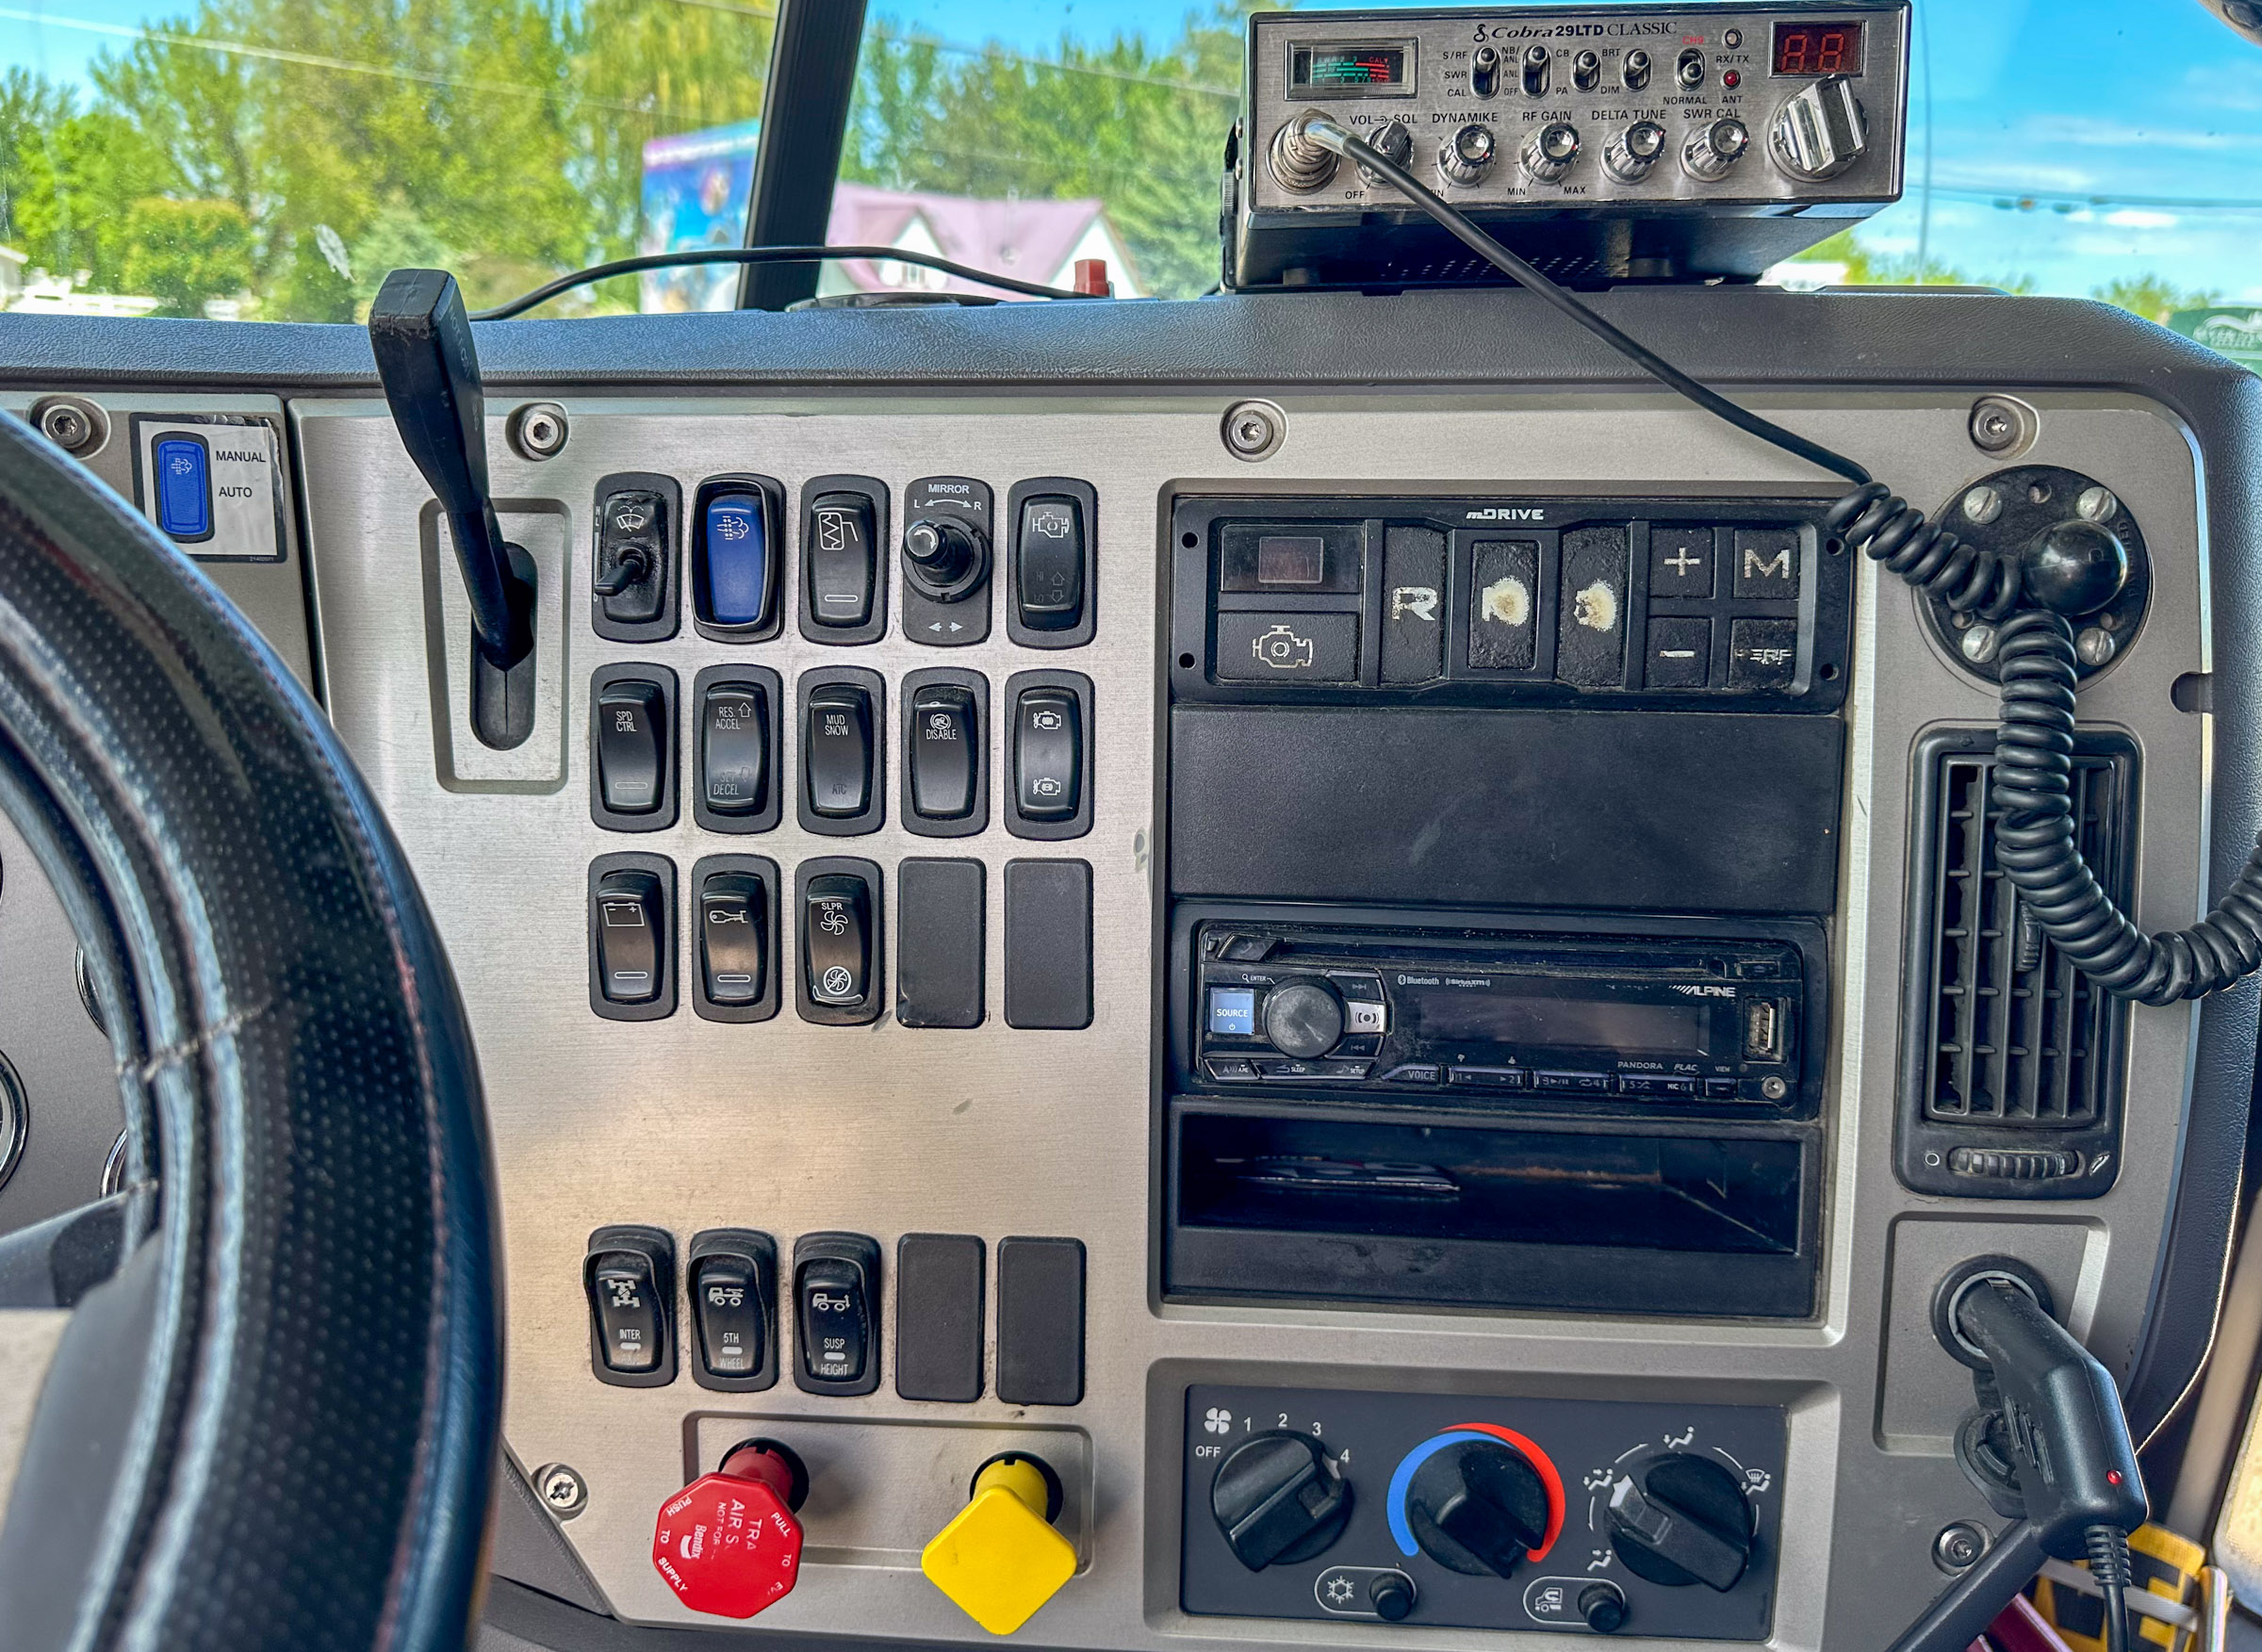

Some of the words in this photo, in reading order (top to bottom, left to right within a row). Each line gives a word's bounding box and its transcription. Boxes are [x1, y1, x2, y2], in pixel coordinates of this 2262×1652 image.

[1492, 25, 1554, 39] Cobra
[1555, 25, 1604, 37] 29LTD
[1607, 22, 1678, 36] CLASSIC
[1682, 36, 1704, 44] CH9
[1443, 51, 1467, 59] S/RF
[1501, 45, 1520, 55] NB/
[1556, 49, 1570, 57] CB
[1502, 56, 1518, 64] ANL
[1715, 55, 1750, 63] RX/TX
[1447, 89, 1467, 97] CAL
[1503, 88, 1518, 96] OFF
[1556, 87, 1568, 95] PA
[1601, 86, 1620, 94] DIM
[1663, 96, 1708, 105] NORMAL
[1394, 114, 1418, 124] SQL
[1432, 112, 1499, 123] DYNAMIKE
[1522, 111, 1537, 122] RF
[1541, 110, 1572, 121] GAIN
[1592, 110, 1629, 121] DELTA
[1633, 109, 1667, 120] TUNE
[1683, 109, 1713, 119] SWR
[1716, 108, 1741, 119] CAL
[1350, 115, 1374, 125] VOL
[1345, 190, 1365, 199] OFF
[216, 450, 267, 463] MANUAL
[219, 486, 253, 498] AUTO
[928, 484, 970, 495] MIRROR
[914, 499, 920, 509] L
[974, 501, 982, 511] R
[1744, 548, 1790, 579] M
[1391, 586, 1438, 622] R
[616, 711, 633, 722] SPD
[827, 714, 845, 726] MUD
[616, 722, 637, 732] CTRL
[715, 718, 741, 730] ACCEL
[825, 726, 848, 736] SNOW
[926, 729, 958, 740] DISABLE
[713, 784, 739, 795] DECEL
[832, 784, 847, 795] ATC
[821, 902, 844, 910] SLPR
[1406, 975, 1440, 986] Bluetooth
[1682, 986, 1736, 997] ALPINE
[1216, 1008, 1249, 1018] SOURCE
[1617, 1061, 1664, 1070] PANDORA
[1408, 1071, 1435, 1081] VOICE
[619, 1329, 641, 1340] INTER
[724, 1332, 740, 1344] 5TH
[824, 1337, 845, 1349] SUSP
[719, 1357, 745, 1370] WHEEL
[821, 1363, 849, 1376] HEIGHT
[1243, 1416, 1253, 1431] 1
[1277, 1413, 1288, 1428] 2
[1312, 1421, 1322, 1436] 3
[1339, 1448, 1351, 1464] 4
[1195, 1446, 1221, 1458] OFF
[666, 1496, 693, 1517] PUSH
[716, 1501, 728, 1523] NOT
[728, 1498, 746, 1529] AIR
[771, 1512, 792, 1537] PULL
[660, 1529, 671, 1545] TO
[691, 1524, 708, 1559] Bendix
[713, 1527, 724, 1546] FOR
[781, 1554, 793, 1567] TO
[658, 1557, 689, 1592] SUPPLY
